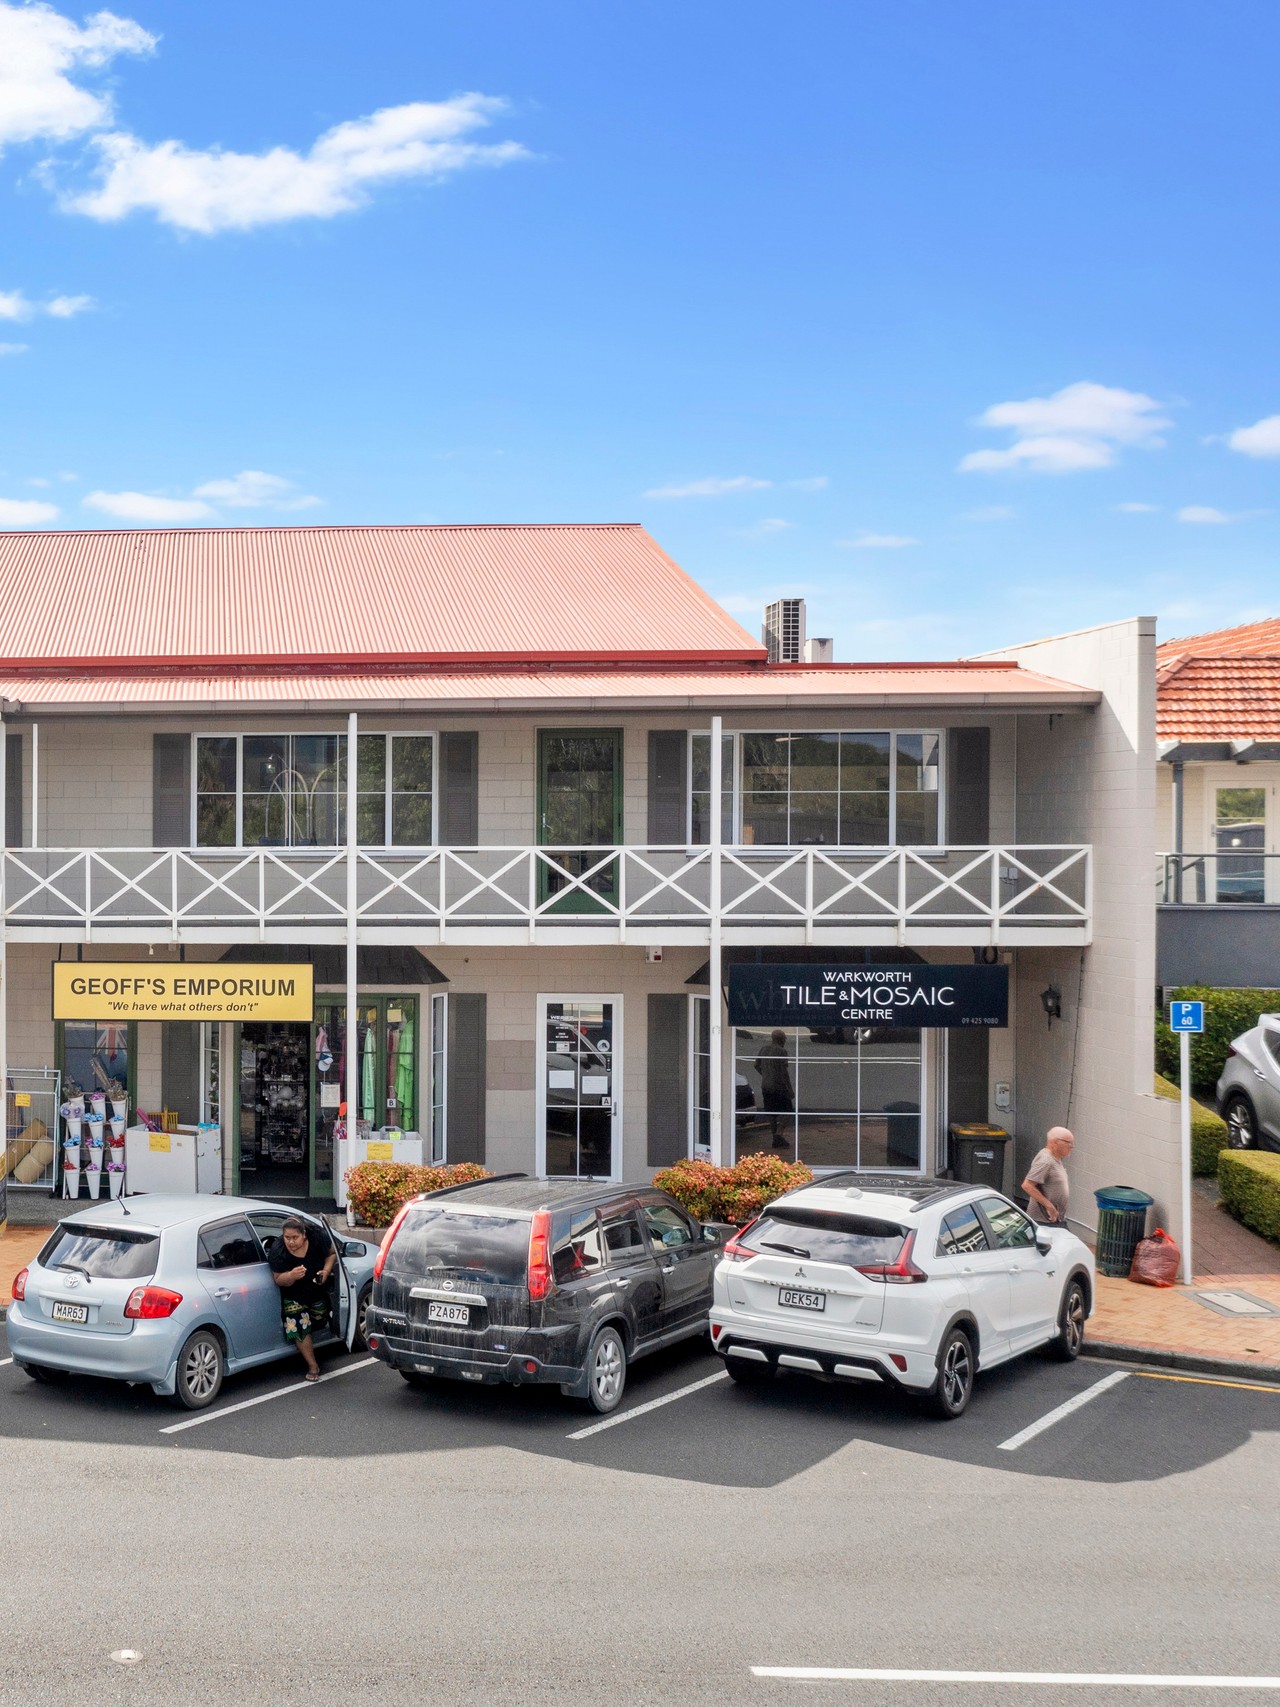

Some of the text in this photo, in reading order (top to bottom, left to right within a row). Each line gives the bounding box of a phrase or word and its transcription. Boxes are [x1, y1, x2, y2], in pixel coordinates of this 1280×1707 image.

[823, 971, 912, 983] WARKWORTH
[70, 978, 295, 996] GEOFF'S EMPORIUM
[780, 986, 837, 1005] TILE
[838, 990, 849, 1001] &
[850, 986, 955, 1006] MOSAIC
[107, 1001, 129, 1011] "We
[131, 1001, 158, 1011] have
[160, 1002, 186, 1012] what
[188, 1002, 223, 1012] others
[1181, 1003, 1192, 1015] P
[841, 1008, 893, 1020] CENTRE
[1181, 1016, 1193, 1025] 60
[784, 1291, 819, 1308] QEK54
[56, 1305, 84, 1320] MAR63
[429, 1304, 468, 1321] PZA876
[382, 1317, 407, 1326] X-TRAIL
